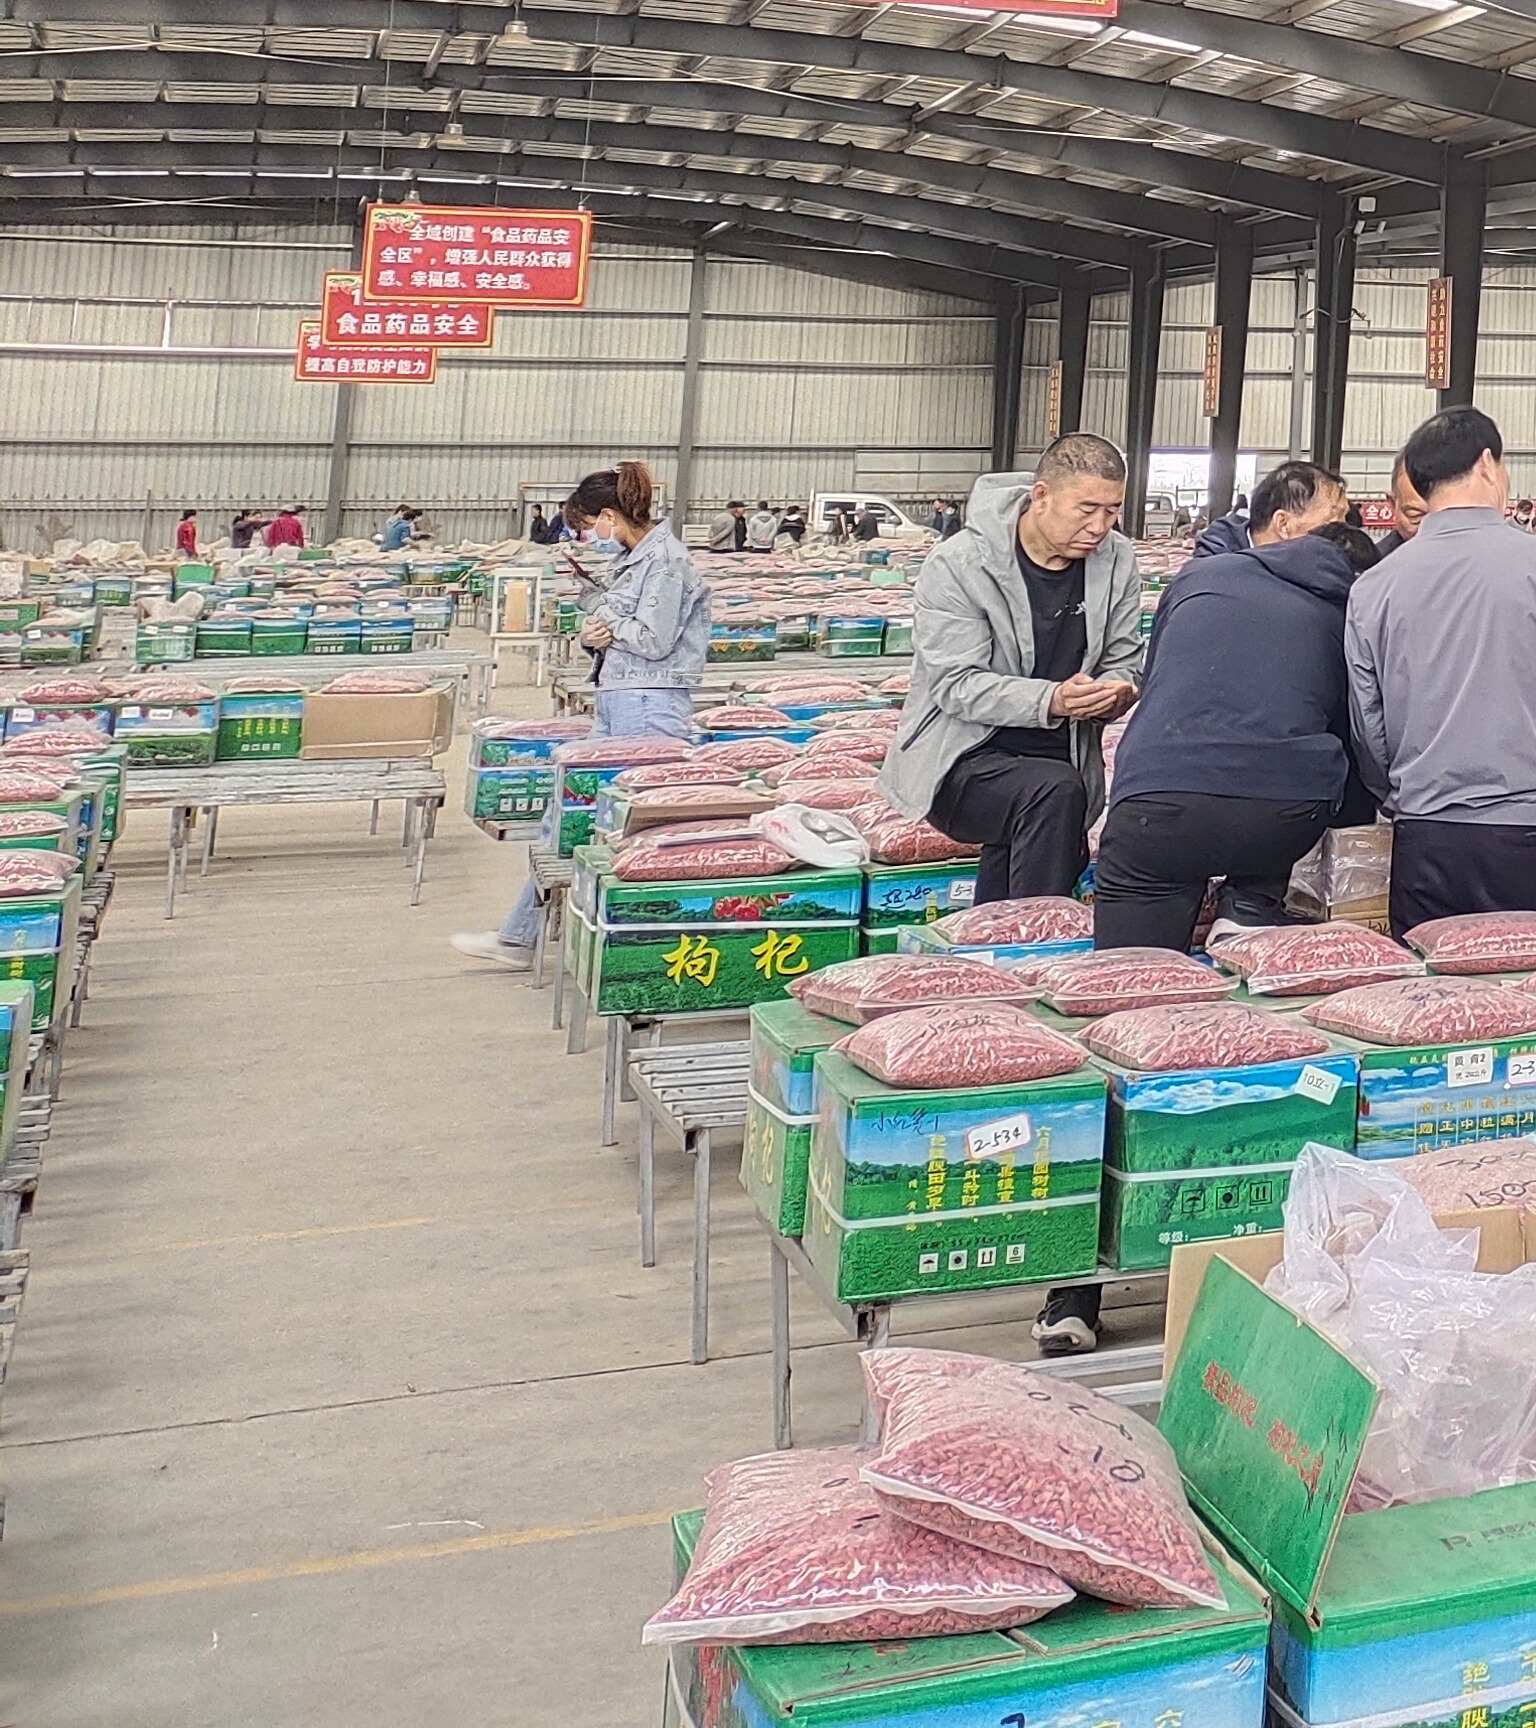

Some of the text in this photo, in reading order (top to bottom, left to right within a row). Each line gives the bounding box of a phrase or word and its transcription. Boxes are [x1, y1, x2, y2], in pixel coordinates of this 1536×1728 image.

[336, 313, 480, 335] 食品药品安全
[662, 928, 809, 989] 枸杞
[973, 1125, 1022, 1153] 2-534
